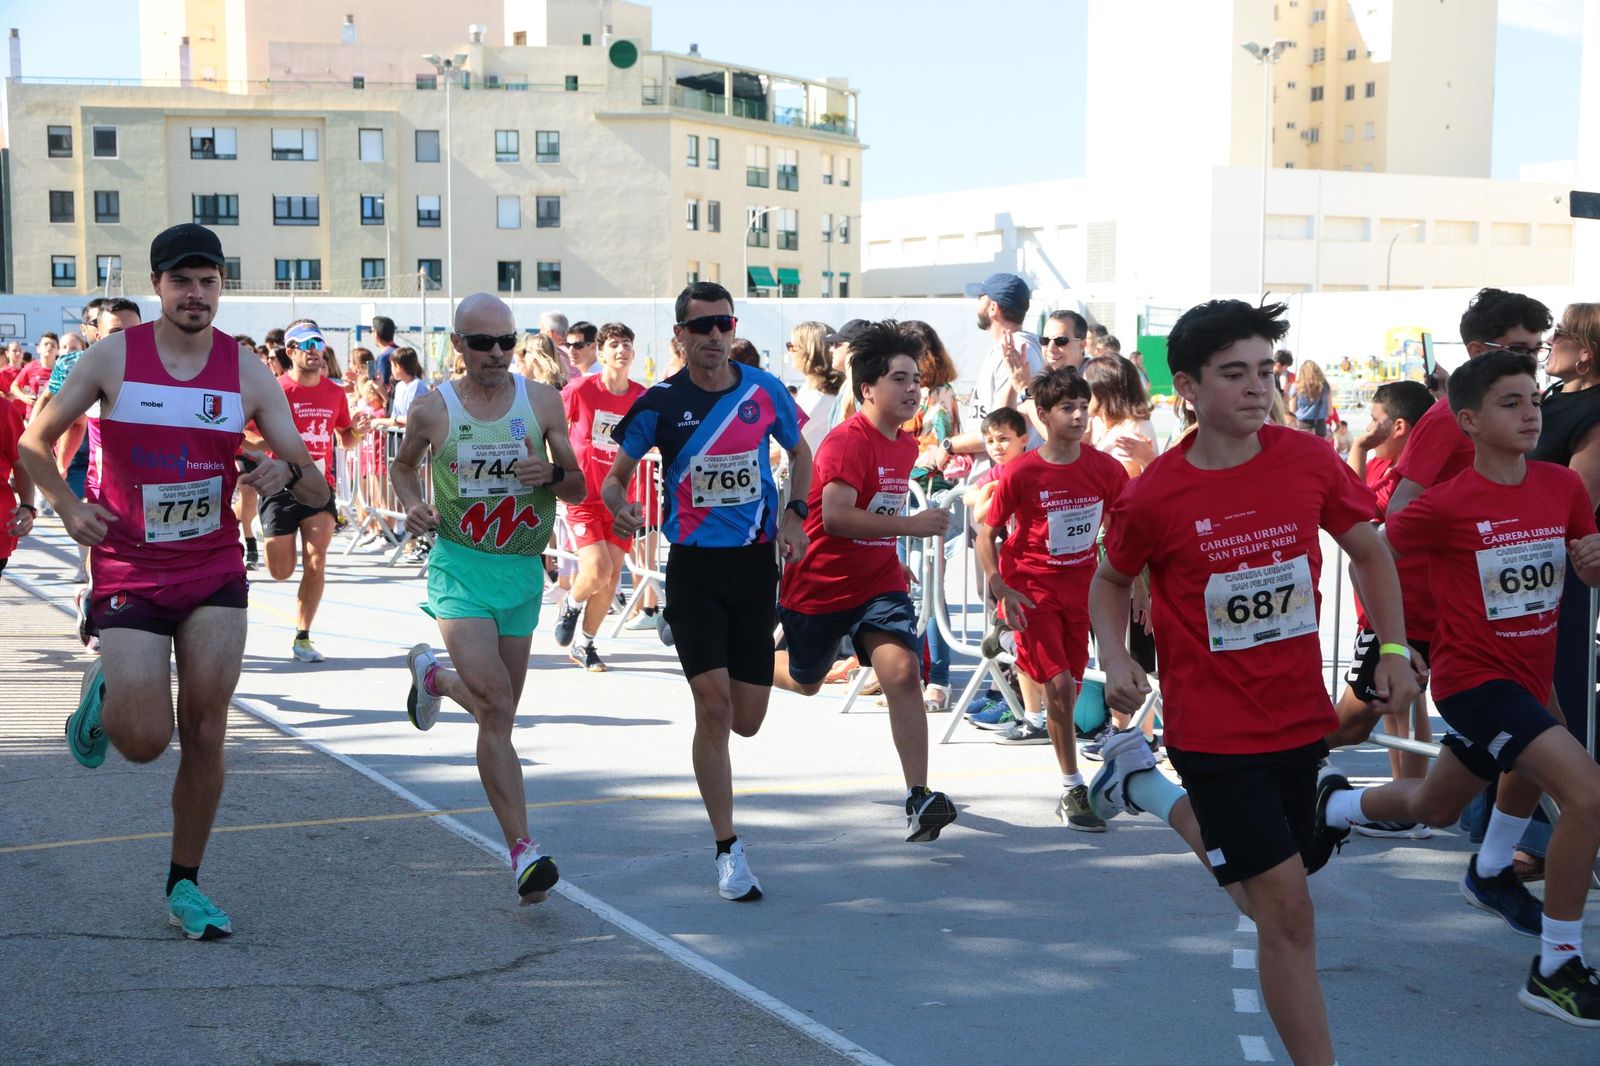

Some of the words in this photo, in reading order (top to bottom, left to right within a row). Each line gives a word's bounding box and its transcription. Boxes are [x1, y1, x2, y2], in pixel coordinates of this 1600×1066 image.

[186, 460, 225, 470] herakles
[471, 458, 518, 479] 744
[703, 468, 750, 490] 766
[159, 496, 210, 522] 775
[1041, 499, 1073, 508] CARRERA
[1067, 523, 1091, 537] 250
[1200, 533, 1254, 552] CARRERA
[1254, 523, 1298, 540] URBANA
[1482, 530, 1530, 545] CARRERA
[1208, 549, 1231, 562] SAN
[1232, 541, 1270, 557] FELIPE
[1271, 535, 1297, 548] NERI
[1224, 570, 1263, 583] CARRERA
[1264, 562, 1295, 576] URBANA
[1500, 561, 1555, 594] 690
[1231, 582, 1249, 592] SAN
[1250, 576, 1276, 589] FELIPE
[1227, 583, 1295, 624] 687
